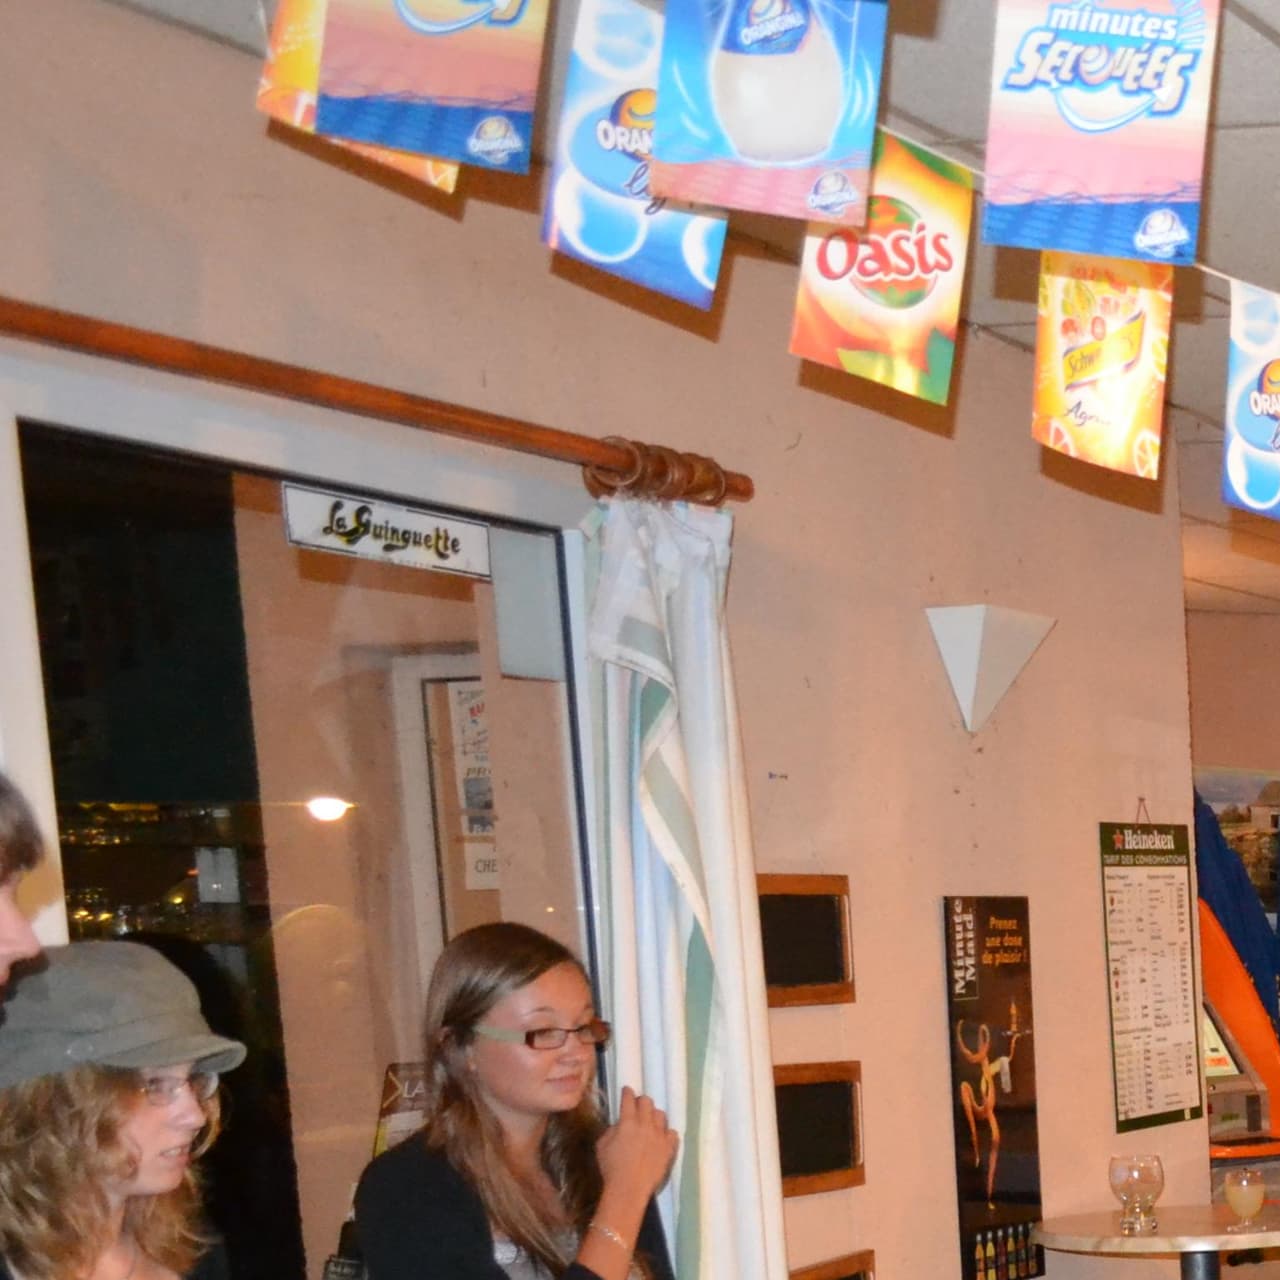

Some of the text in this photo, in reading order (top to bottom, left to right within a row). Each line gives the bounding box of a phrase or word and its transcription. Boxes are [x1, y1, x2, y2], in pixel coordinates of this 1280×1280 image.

[1049, 5, 1179, 41] minutes
[597, 119, 654, 152] ORAN
[815, 223, 953, 281] Oasis
[1123, 828, 1175, 850] Heineken
[952, 898, 967, 994] Minute
